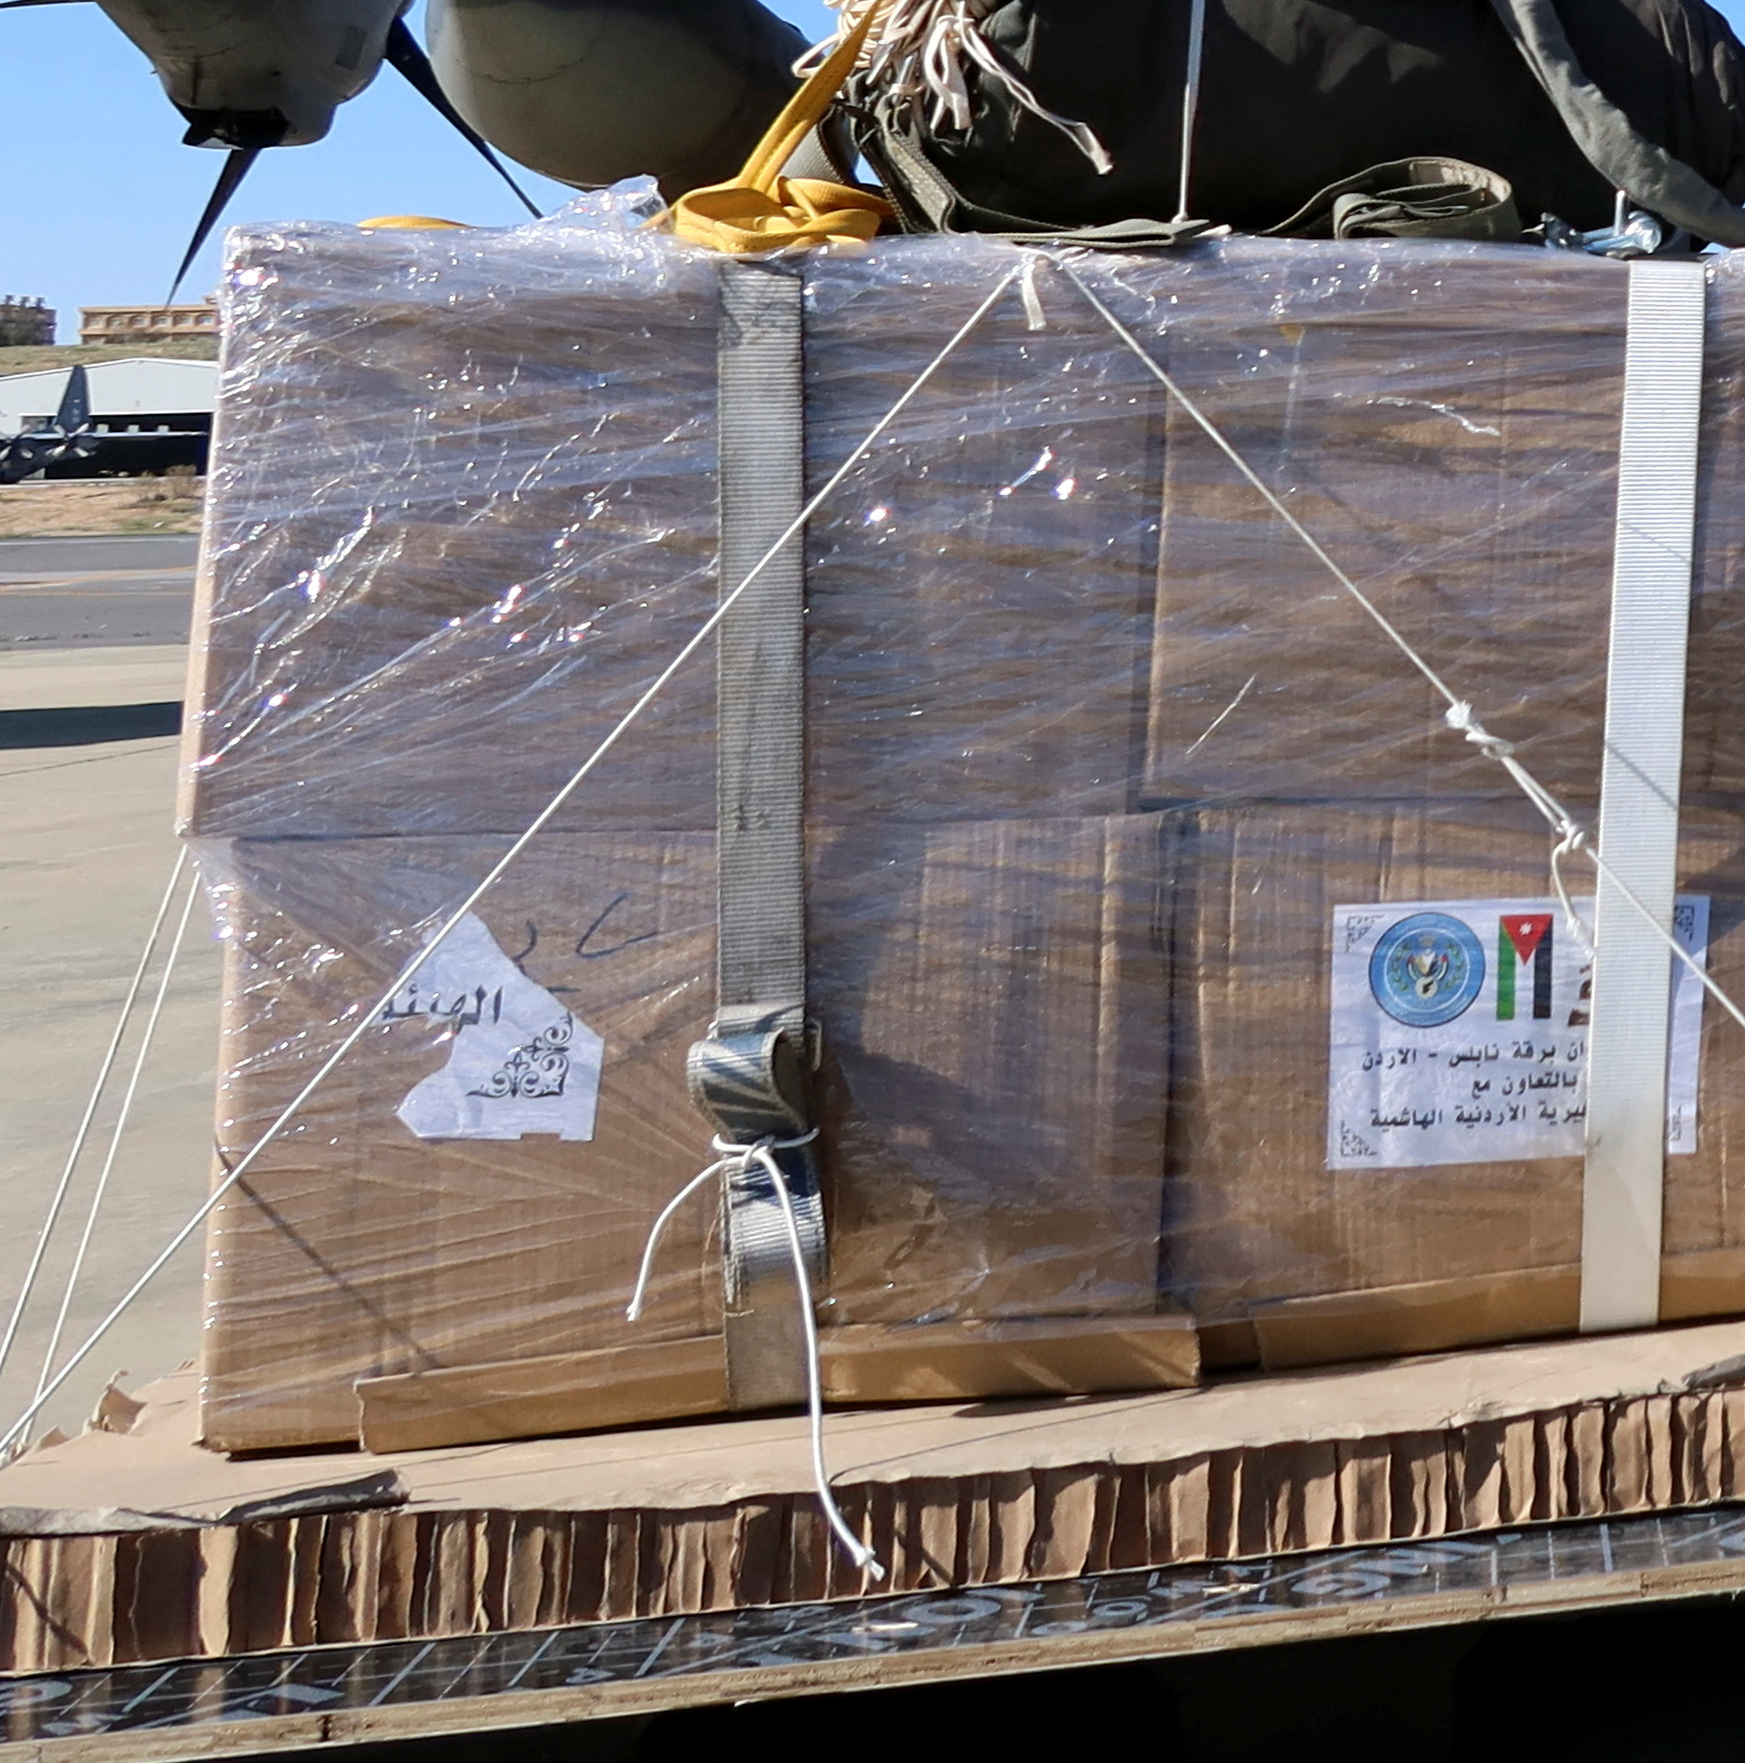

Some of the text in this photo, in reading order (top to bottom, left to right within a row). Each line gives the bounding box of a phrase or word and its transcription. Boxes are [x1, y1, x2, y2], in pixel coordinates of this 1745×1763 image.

[1448, 1043, 1500, 1068] نابلس
[1511, 1039, 1557, 1064] برقة
[1471, 1071, 1578, 1099] بالتعاون مع
[1370, 1106, 1443, 1133] الهاشمية
